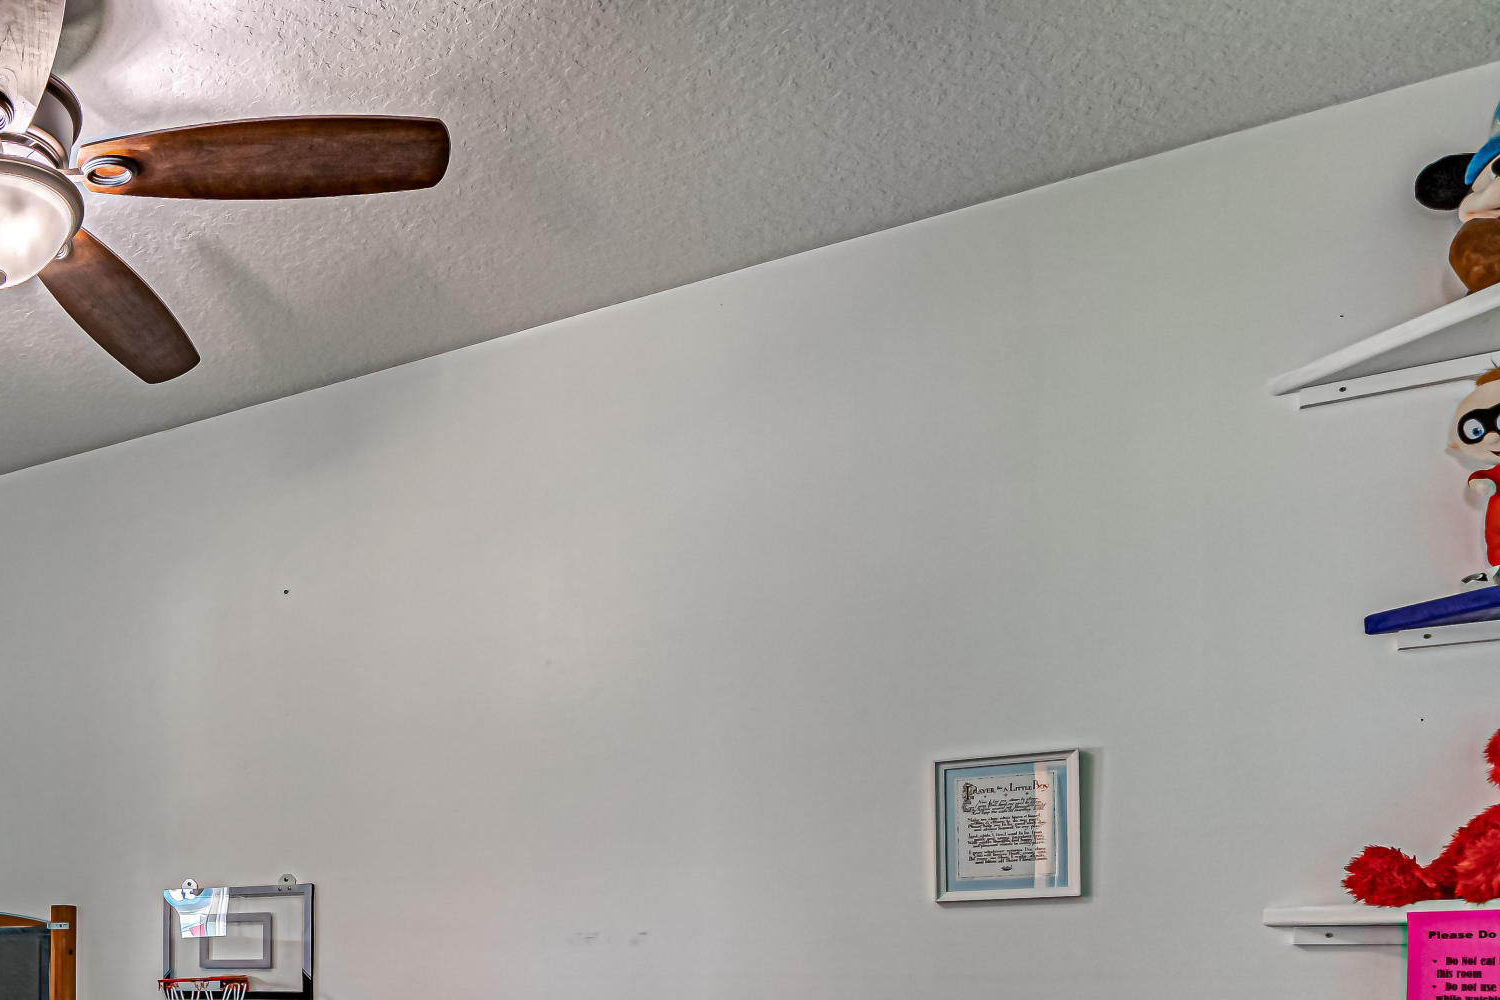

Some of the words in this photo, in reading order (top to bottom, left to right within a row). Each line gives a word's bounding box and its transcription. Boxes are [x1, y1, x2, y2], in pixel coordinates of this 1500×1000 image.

[1428, 930, 1473, 939] Please
[1478, 930, 1497, 939] Do
[1445, 956, 1458, 965] Do
[1461, 956, 1477, 965] Not
[1480, 956, 1496, 966] eat
[1436, 969, 1453, 978] this
[1456, 969, 1482, 978] room
[1445, 982, 1458, 991] Do
[1461, 982, 1477, 991] not
[1480, 983, 1497, 992] use
